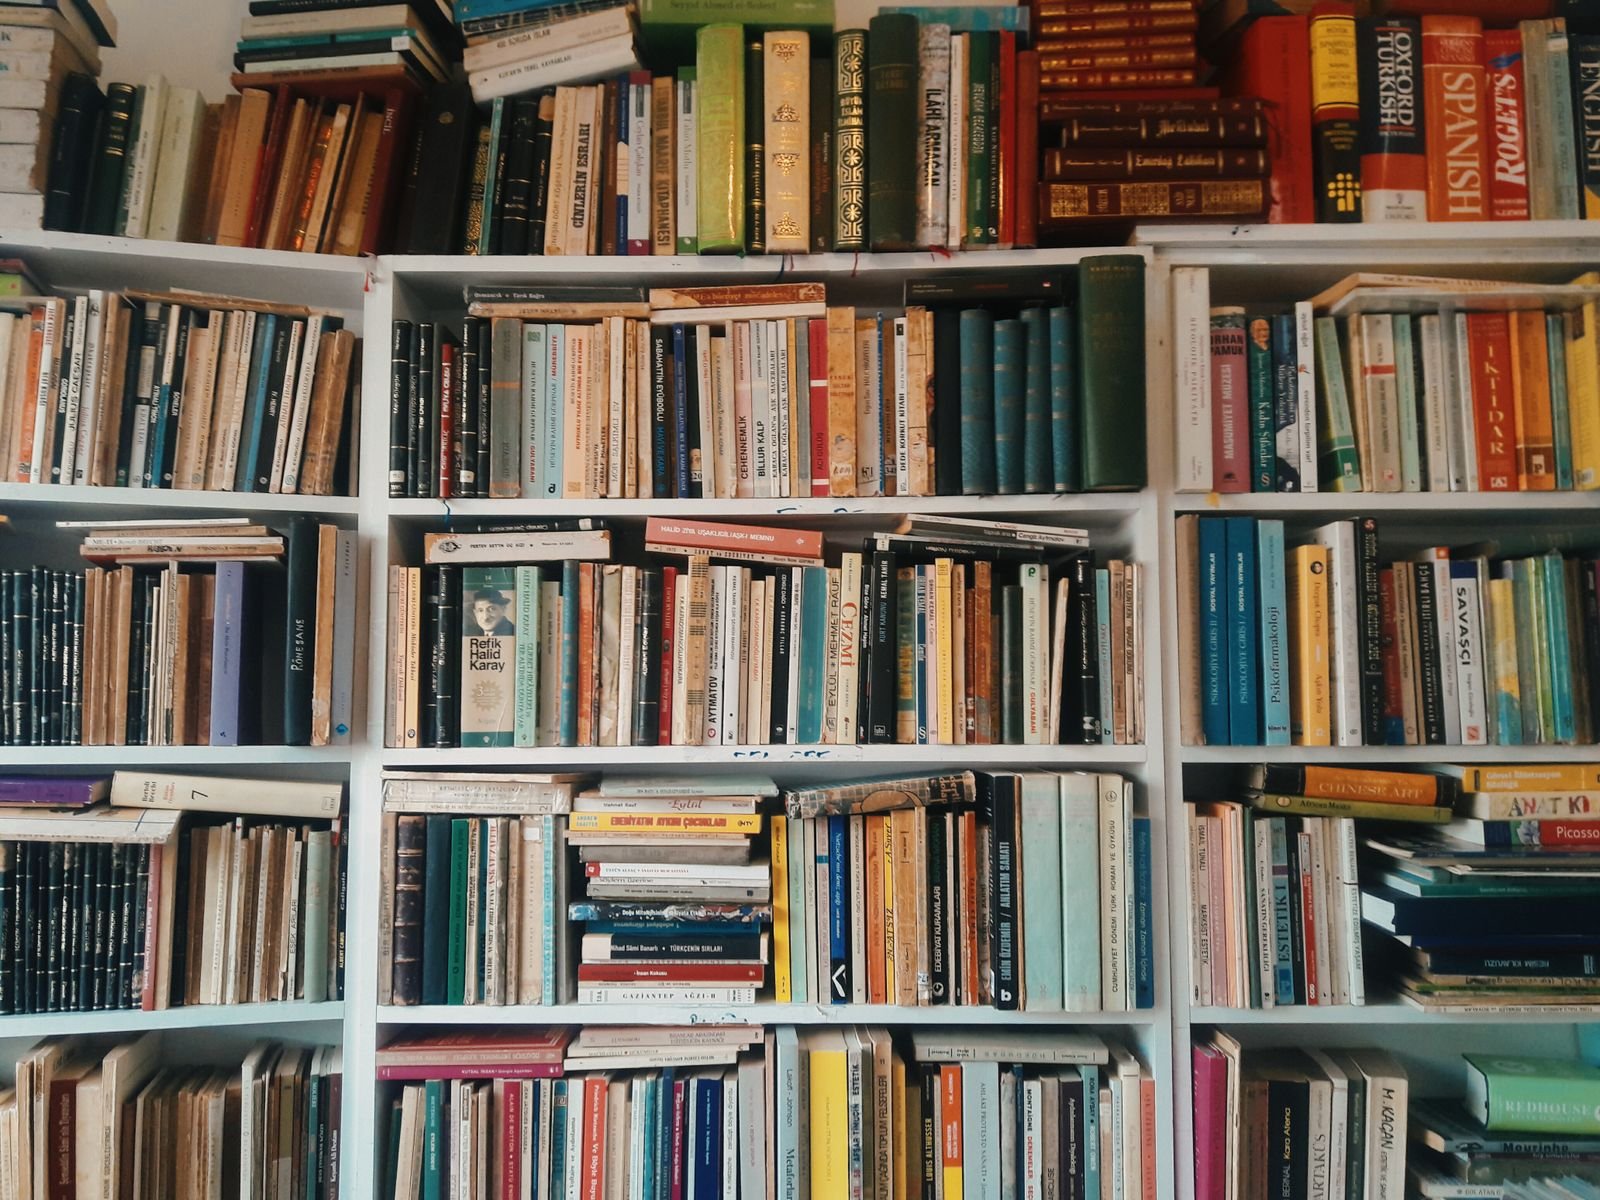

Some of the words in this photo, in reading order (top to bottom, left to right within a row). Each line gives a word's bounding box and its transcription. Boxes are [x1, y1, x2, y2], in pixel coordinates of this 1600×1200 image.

[1376, 32, 1398, 125] TURKISH
[1395, 32, 1415, 127] OXFORD
[1489, 72, 1527, 188] ROGET'S
[574, 123, 591, 168] ESRARI
[924, 124, 945, 187] ARMAĞAN
[1441, 72, 1482, 216] SPANISH
[572, 170, 587, 229] CİNLERİN
[1210, 335, 1244, 345] RHAN
[1210, 346, 1243, 355] AMUK
[655, 339, 664, 383] SABAHATTİN
[1221, 364, 1232, 399] MÜZESİ
[656, 385, 665, 422] EYÜBOĞLU
[770, 398, 778, 412] AŞK
[1223, 403, 1234, 459] MASUMİYET
[816, 458, 824, 470] ACI
[879, 560, 888, 578] TAHİR
[831, 577, 839, 608] RAUF
[880, 579, 888, 598] KEMAL
[918, 576, 926, 594] ORHAN
[918, 595, 926, 614] KEMAL
[1209, 586, 1217, 612] SOSYAL
[879, 601, 887, 625] KANUNU
[470, 638, 501, 649] Refik
[829, 611, 839, 659] MEHMET
[470, 649, 500, 659] Halid
[470, 661, 505, 673] Karay
[1268, 606, 1282, 704] Psikofarmakoloji
[708, 676, 718, 723] AYTMATOV
[827, 671, 837, 707] EYLÜL
[141, 780, 150, 802] Bertolt
[149, 781, 157, 802] Brecht
[191, 789, 209, 801] 7
[1319, 782, 1388, 797] CHINESE
[1392, 785, 1424, 800] ART
[670, 799, 703, 811] Eylül
[1299, 800, 1324, 810] African
[610, 814, 653, 827] EDEBİYATIN
[656, 816, 681, 826] AYKIRI
[683, 816, 727, 829] ÇOCUKLARI
[1108, 820, 1117, 849] ÖYKÜSÜ
[1556, 826, 1600, 838] Picasso
[999, 841, 1011, 871] SANATI
[1110, 852, 1116, 862] VE
[1000, 873, 1011, 908] ANLATIM
[932, 886, 942, 935] KURAMLARI
[1200, 905, 1208, 936] MARKSİST
[999, 922, 1012, 958] ÖZDEMİR
[1110, 915, 1118, 944] DÖNEMİ
[670, 944, 700, 953] TÜRKÇENİN
[702, 944, 723, 953] SIRLARI
[933, 935, 942, 972] EDEBİYAT
[1201, 938, 1209, 965] ESTETİK
[1000, 960, 1012, 981] EMİN
[1110, 947, 1119, 992] CUMHURİYET
[623, 991, 675, 1000] GAZİANTEP
[851, 1064, 860, 1095] ESTETİK
[877, 1074, 887, 1118] FELSEFELERİ
[1505, 1100, 1589, 1115] REDHOUSE
[592, 1143, 598, 1153] Ve
[878, 1120, 887, 1149] TOPLUM
[925, 1118, 933, 1158] ALTHUSSER
[1503, 1142, 1569, 1153] Mourinho
[852, 1136, 862, 1162] AFŞAR
[590, 1155, 598, 1177] Böyle
[1282, 1163, 1291, 1198] BERNAL
